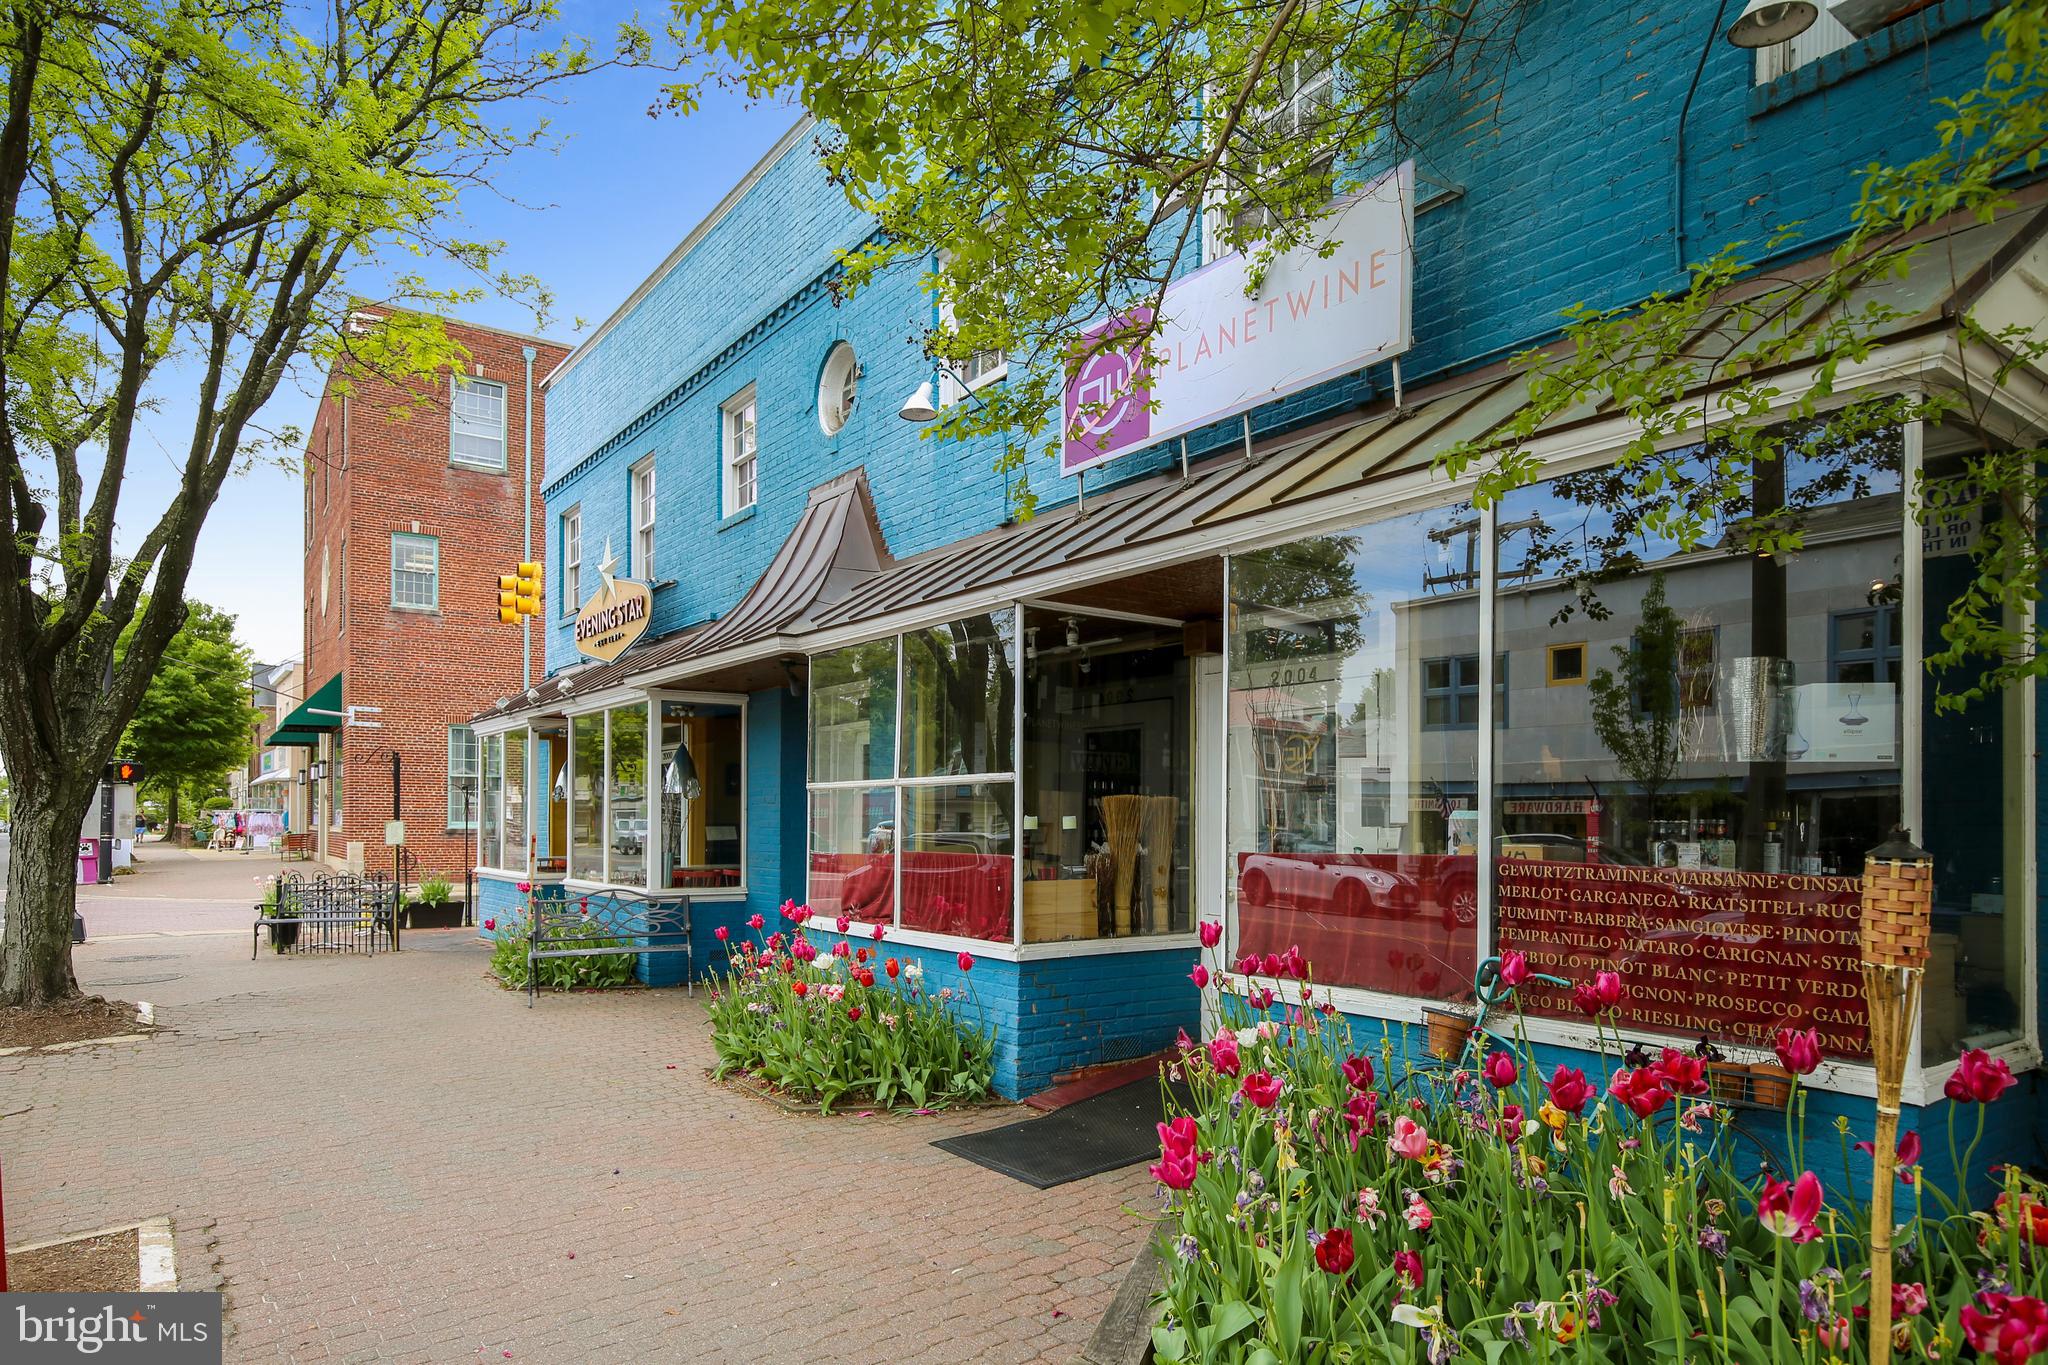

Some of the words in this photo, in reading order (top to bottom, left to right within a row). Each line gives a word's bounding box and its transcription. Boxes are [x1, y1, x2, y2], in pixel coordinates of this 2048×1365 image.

[1158, 248, 1387, 380] PLANETWINE
[576, 604, 617, 641] EVENING
[618, 595, 645, 625] STAR
[1270, 666, 1318, 687] 2004
[1498, 863, 1664, 884] GEWURTZTRAMINER
[1672, 871, 1779, 889] MARSANNE
[1498, 884, 1564, 900] MERLOT
[1570, 889, 1680, 908] GARGANEGA
[1688, 896, 1807, 917] RKATSITELI
[1498, 905, 1568, 923] FURMINT
[1573, 911, 1649, 929] BARBERA
[1655, 917, 1775, 939] SANGIOVESE
[1497, 926, 1612, 949] TEMPRANILLO
[1619, 937, 1694, 957] MATARO
[1703, 945, 1811, 968] CARIGNAN
[1498, 948, 1581, 969] BIOLO
[1589, 957, 1647, 976] PINOT
[1652, 964, 1717, 983] BLANC
[1727, 971, 1791, 992] PETIT
[1695, 992, 1802, 1018] PROSECCO
[1632, 1008, 1722, 1033] RIESLING
[1733, 1022, 1874, 1054] CHAONN
